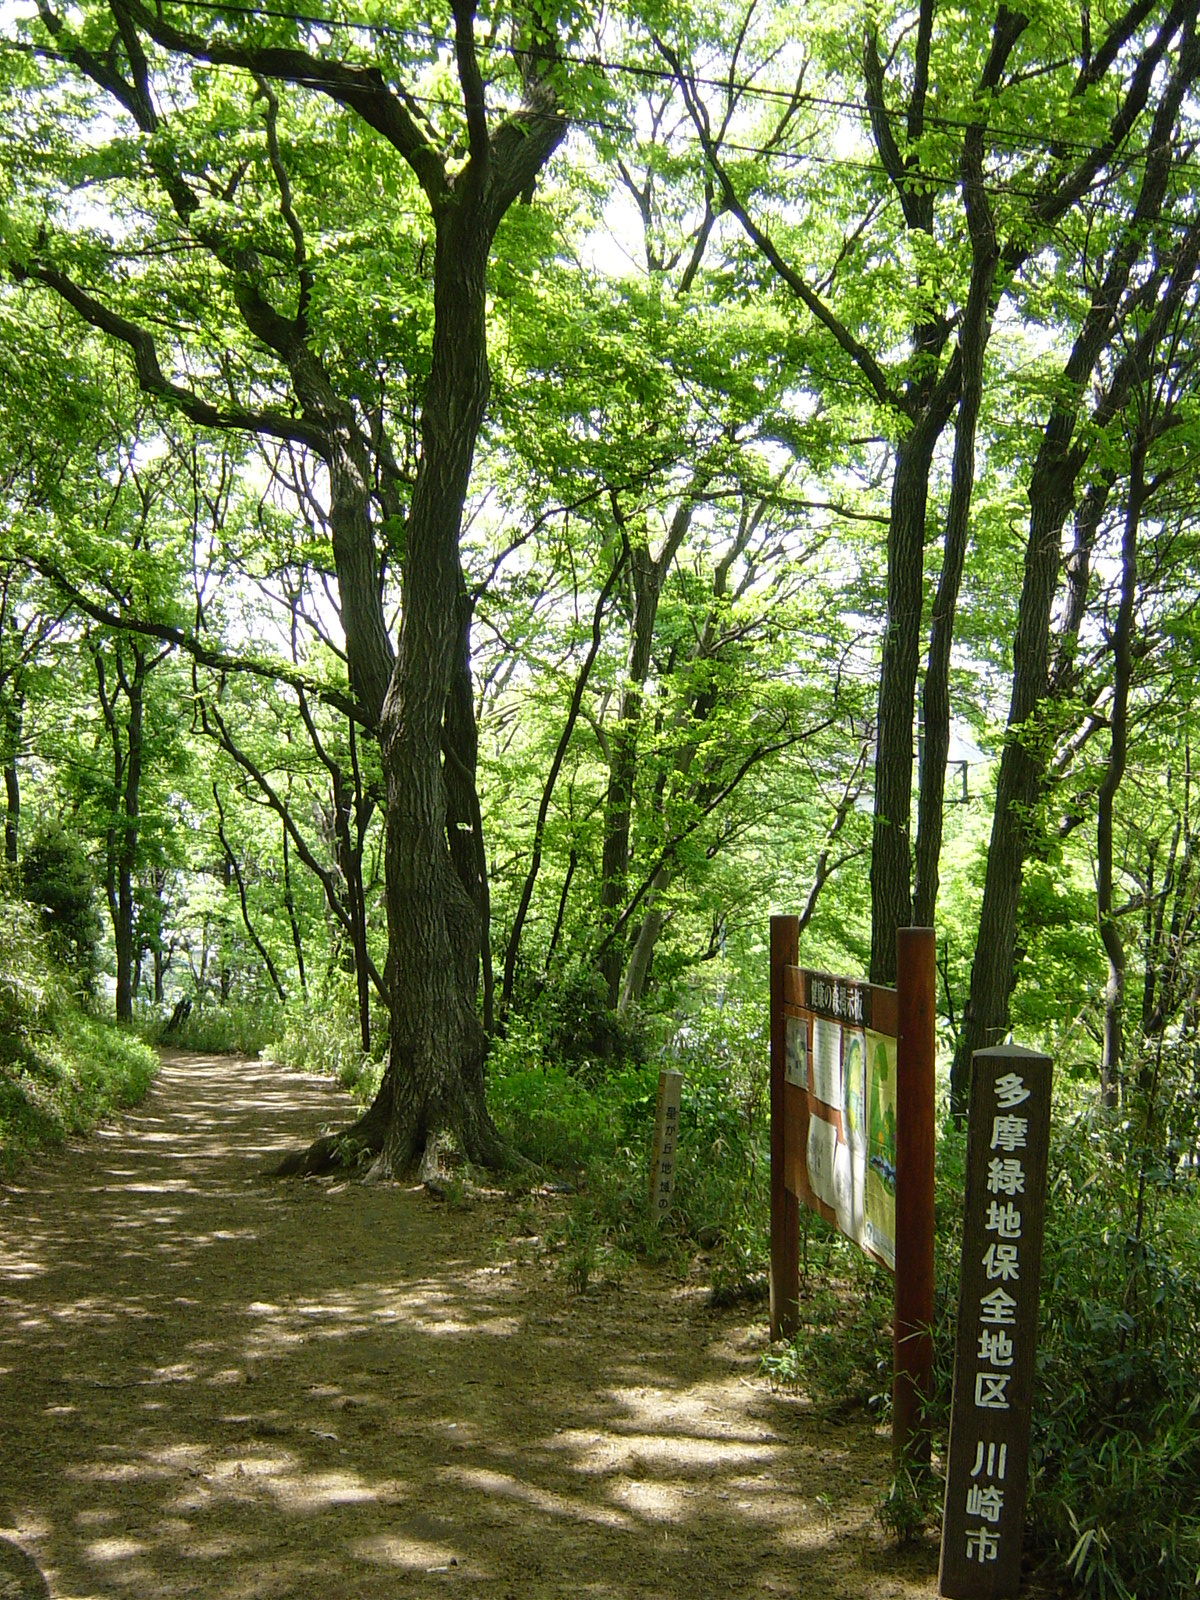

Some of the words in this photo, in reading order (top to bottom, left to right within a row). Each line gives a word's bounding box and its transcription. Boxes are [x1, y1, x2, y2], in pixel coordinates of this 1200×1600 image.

[974, 1072, 1031, 1409] 多摩緑地保全地区
[965, 1440, 1008, 1563] 川崎市
